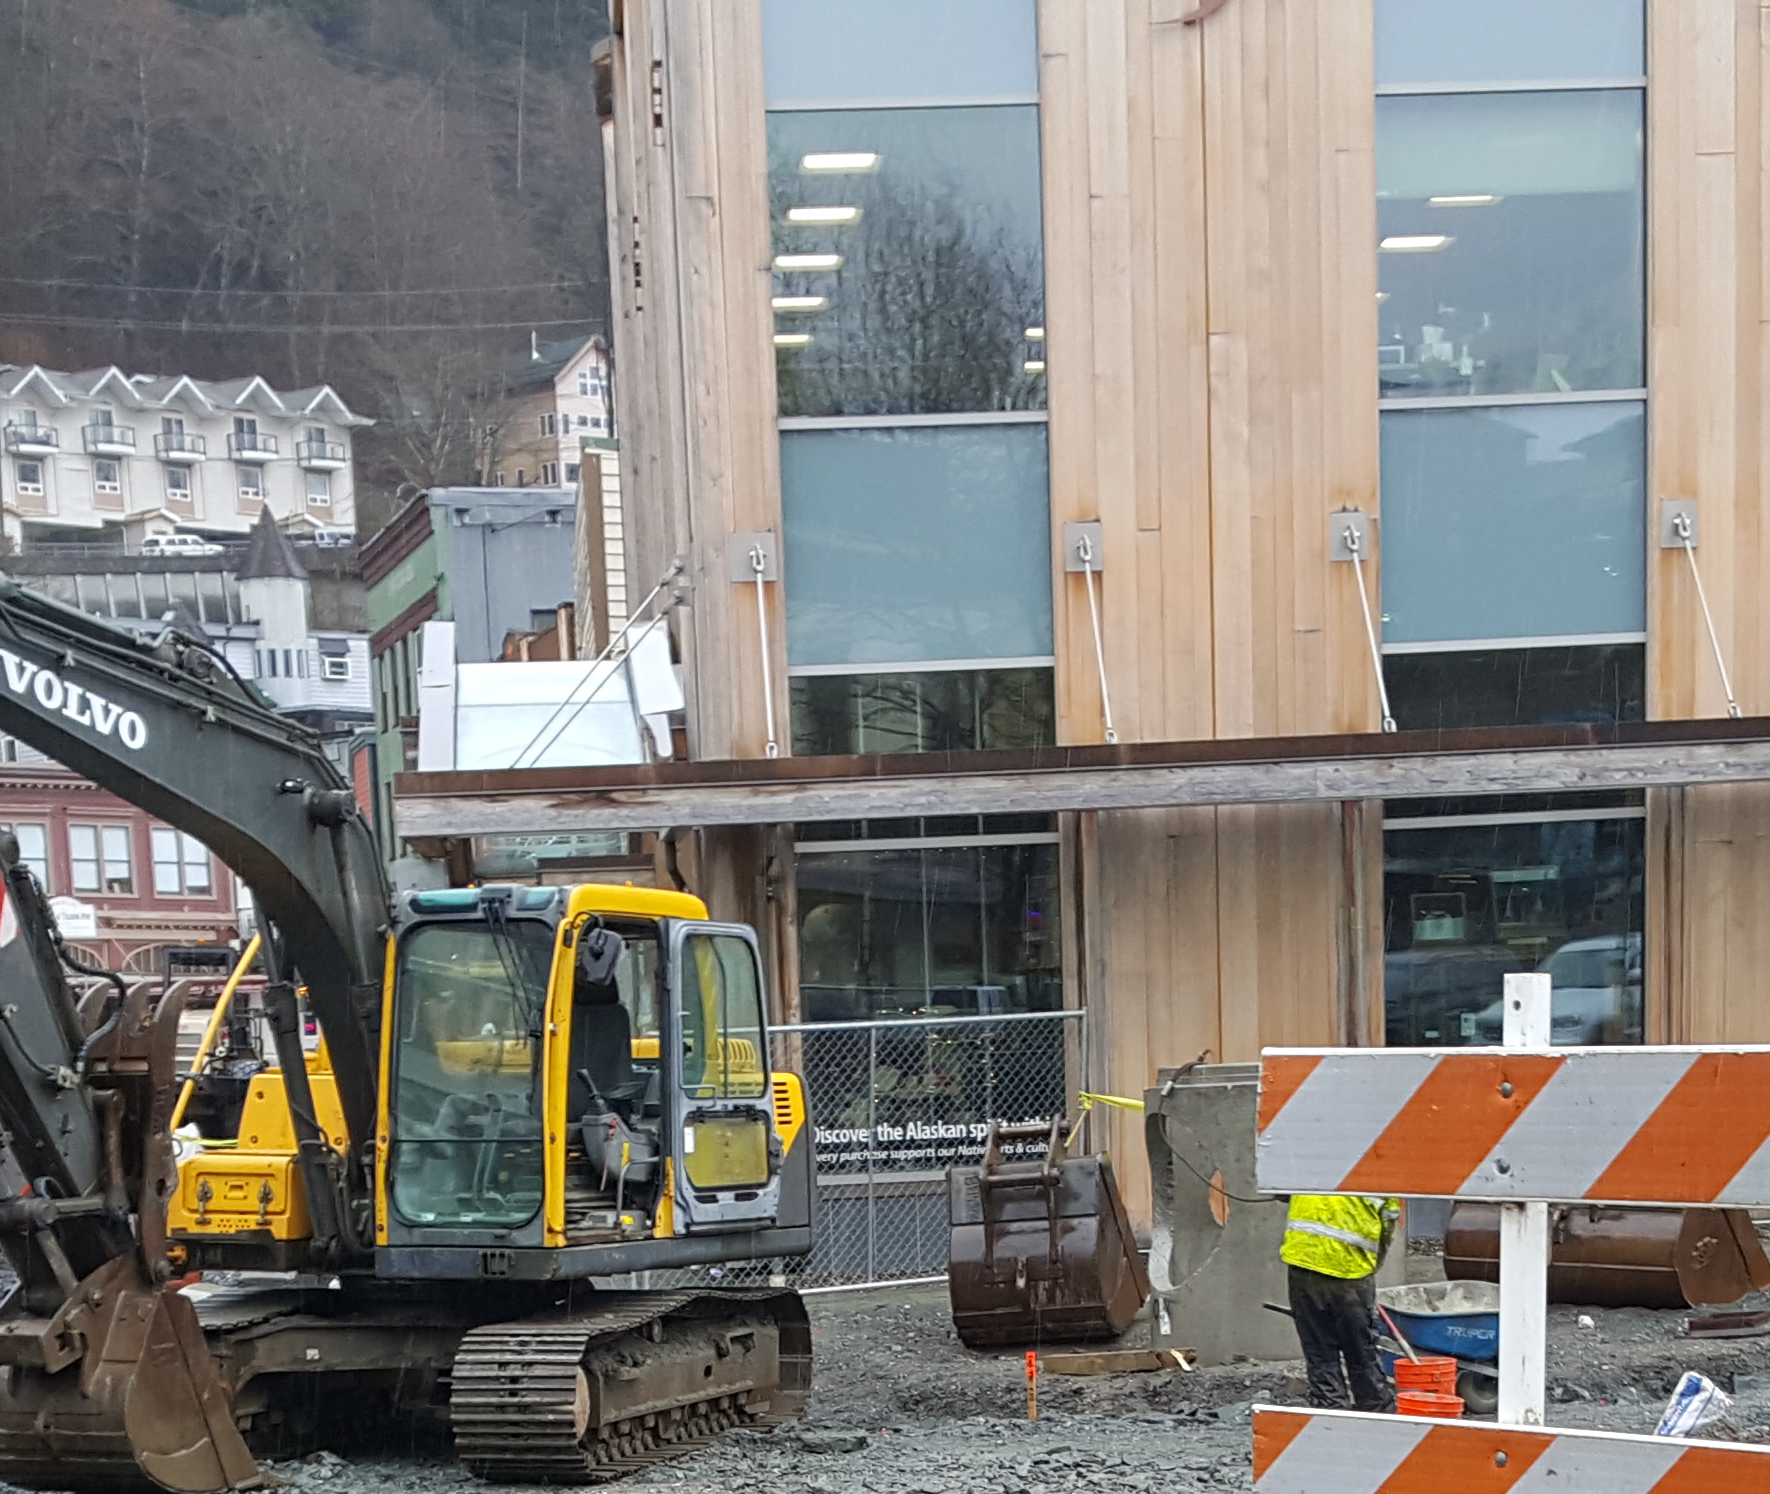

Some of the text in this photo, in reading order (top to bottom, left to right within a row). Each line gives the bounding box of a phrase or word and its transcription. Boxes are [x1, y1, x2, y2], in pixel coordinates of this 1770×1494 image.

[876, 1122, 904, 1141] the
[906, 1120, 966, 1140] Alaskan
[969, 1118, 1008, 1142] spit
[816, 1151, 839, 1164] very
[889, 1145, 935, 1161] supports
[937, 1146, 957, 1157] our
[957, 1144, 987, 1157] Nativ
[999, 1144, 1015, 1155] rts
[1025, 1142, 1050, 1154] cultu
